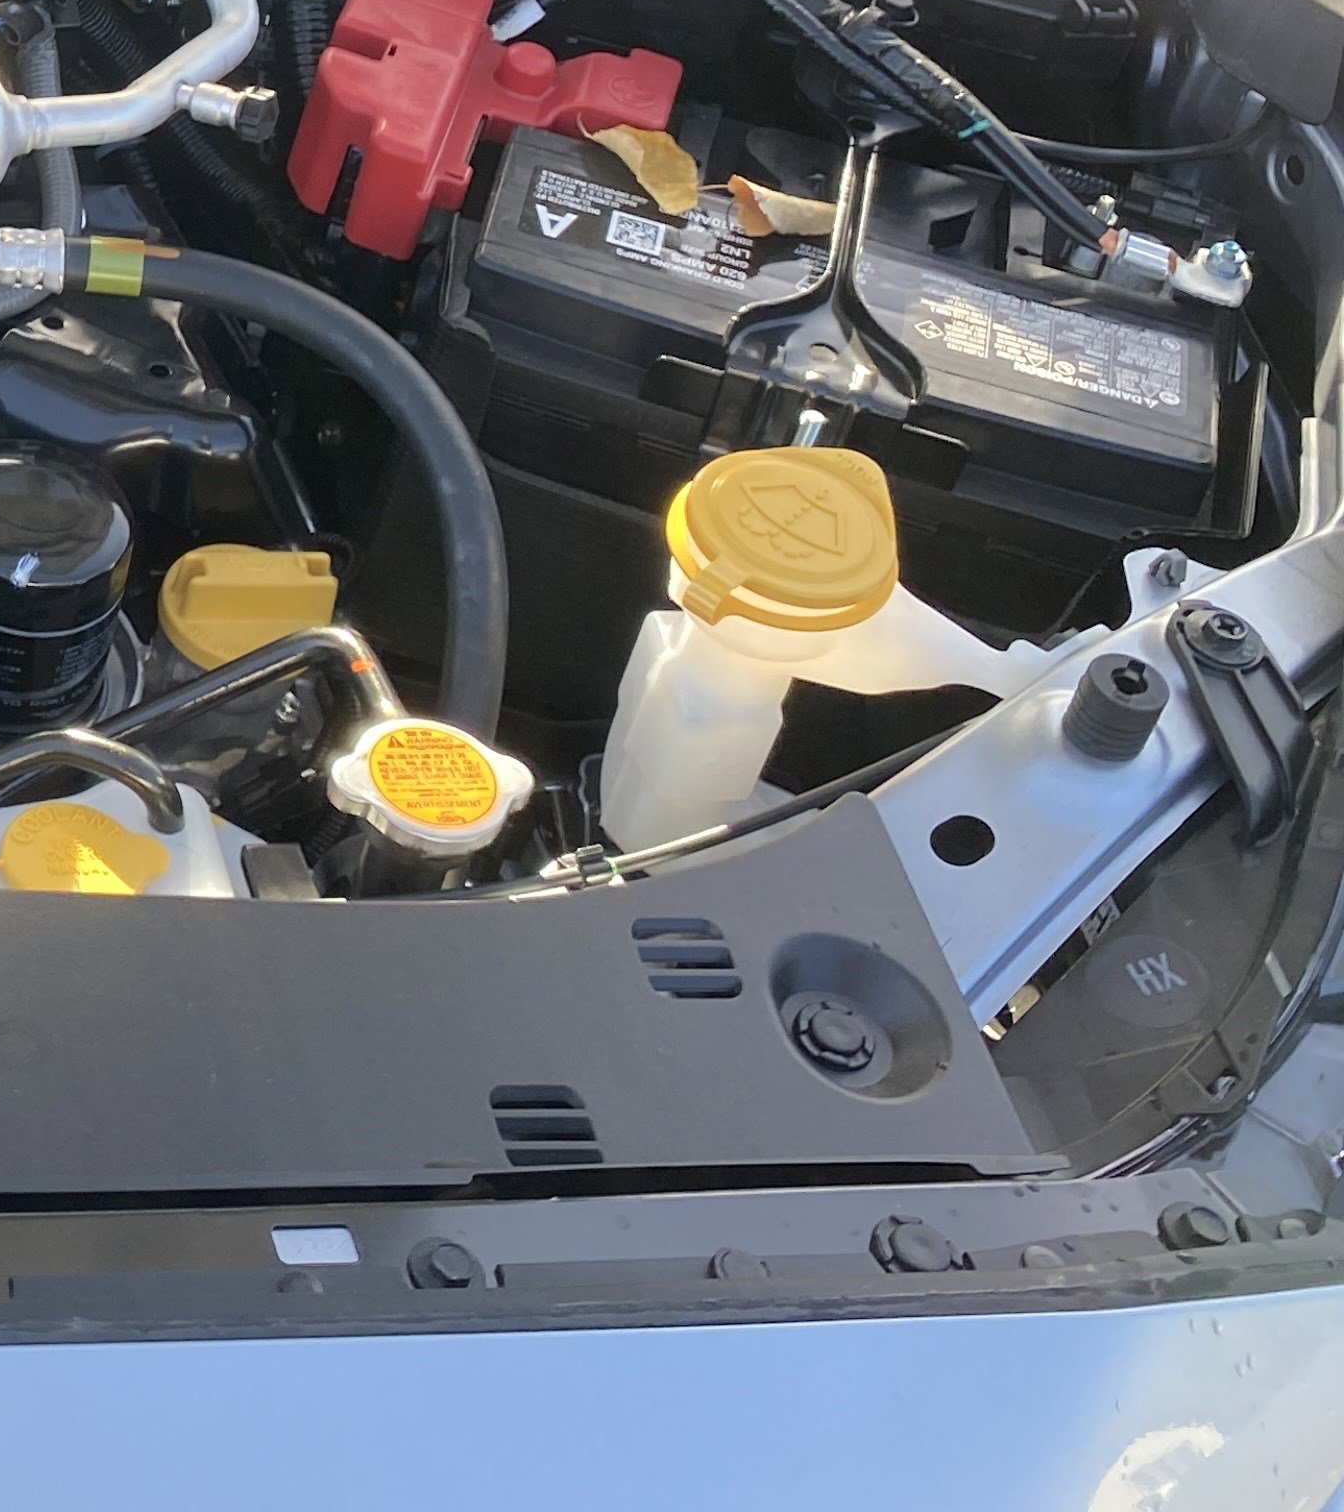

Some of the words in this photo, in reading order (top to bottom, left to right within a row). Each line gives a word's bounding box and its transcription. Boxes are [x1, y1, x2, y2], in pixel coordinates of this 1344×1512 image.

[614, 247, 648, 263] AMPS
[718, 241, 751, 259] LN2
[648, 256, 710, 280] CRANKING
[669, 251, 716, 272] AMPS
[717, 265, 747, 281] 620
[1012, 361, 1144, 405] DANGER/POISON
[11, 808, 125, 843] COOLANT
[1125, 952, 1188, 996] HX
